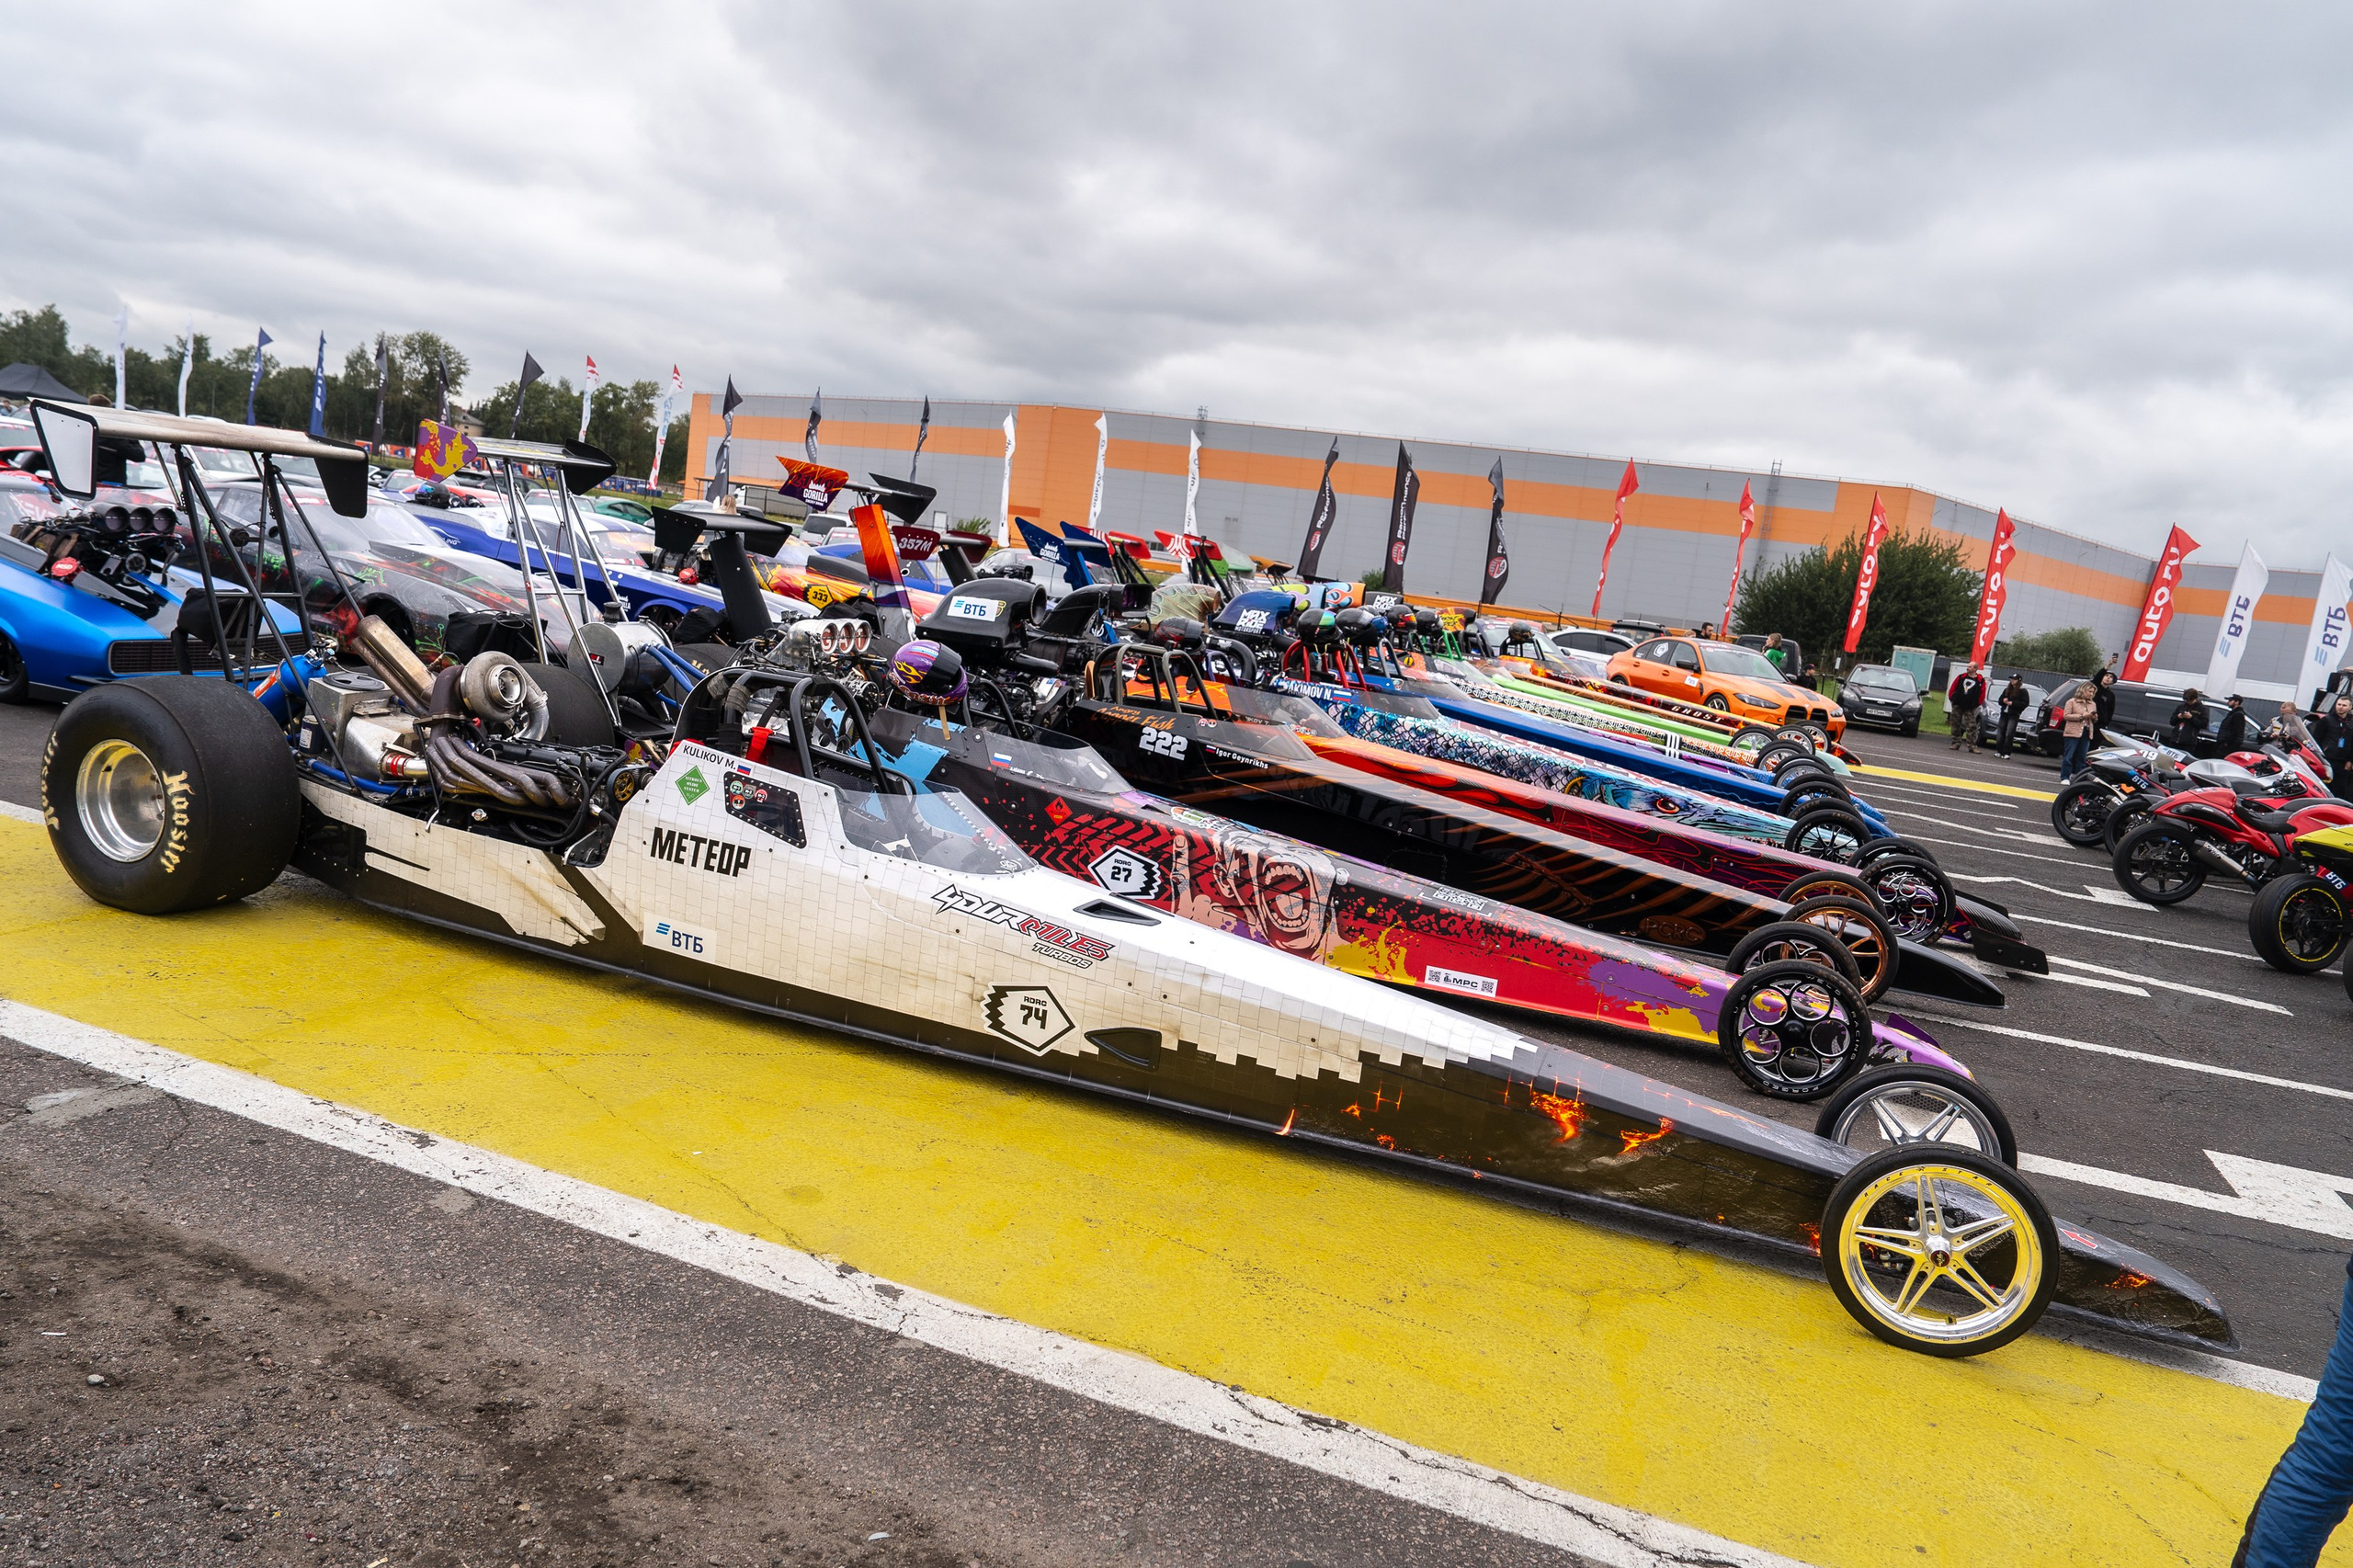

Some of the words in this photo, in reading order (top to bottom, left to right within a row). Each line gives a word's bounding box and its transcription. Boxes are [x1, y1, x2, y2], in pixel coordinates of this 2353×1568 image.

[803, 488, 828, 504] GORILLA
[898, 536, 933, 552] 357M
[55, 562, 74, 571] MSD
[812, 590, 829, 603] 333
[963, 603, 987, 617] ВТБ
[2227, 595, 2251, 638] ВТБ
[1234, 627, 1262, 635] MOTORSPORT
[2322, 606, 2347, 648] ВТБ
[1288, 684, 1323, 699] AKIMOV
[1324, 688, 1333, 700] N.
[1670, 704, 1726, 723] GHOST
[1141, 715, 1177, 731] Fish
[1139, 726, 1188, 761] 222
[683, 744, 724, 766] KULIKOV
[724, 758, 736, 771] M.
[1215, 747, 1231, 761] Igor
[1231, 751, 1269, 769] Geynrikhs
[2165, 749, 2180, 760] ВТБ
[2131, 775, 2150, 790] ВТБ
[160, 769, 196, 873] Hoosier
[650, 826, 752, 877] МЕТЕОР
[1110, 865, 1132, 882] 27
[1799, 899, 1849, 914] THOMPSON
[671, 930, 704, 953] ВТБ
[1031, 942, 1093, 969] TURBOS
[1452, 977, 1479, 988] MPC
[1023, 995, 1048, 1007] RDRC
[1019, 1004, 1048, 1029] 74
[1805, 974, 1841, 995] WELD
[1850, 1011, 1861, 1061] RACING
[1762, 1080, 1819, 1093] FORGED
[1863, 1171, 1904, 1198] RACE
[1941, 1167, 1993, 1187] STAR
